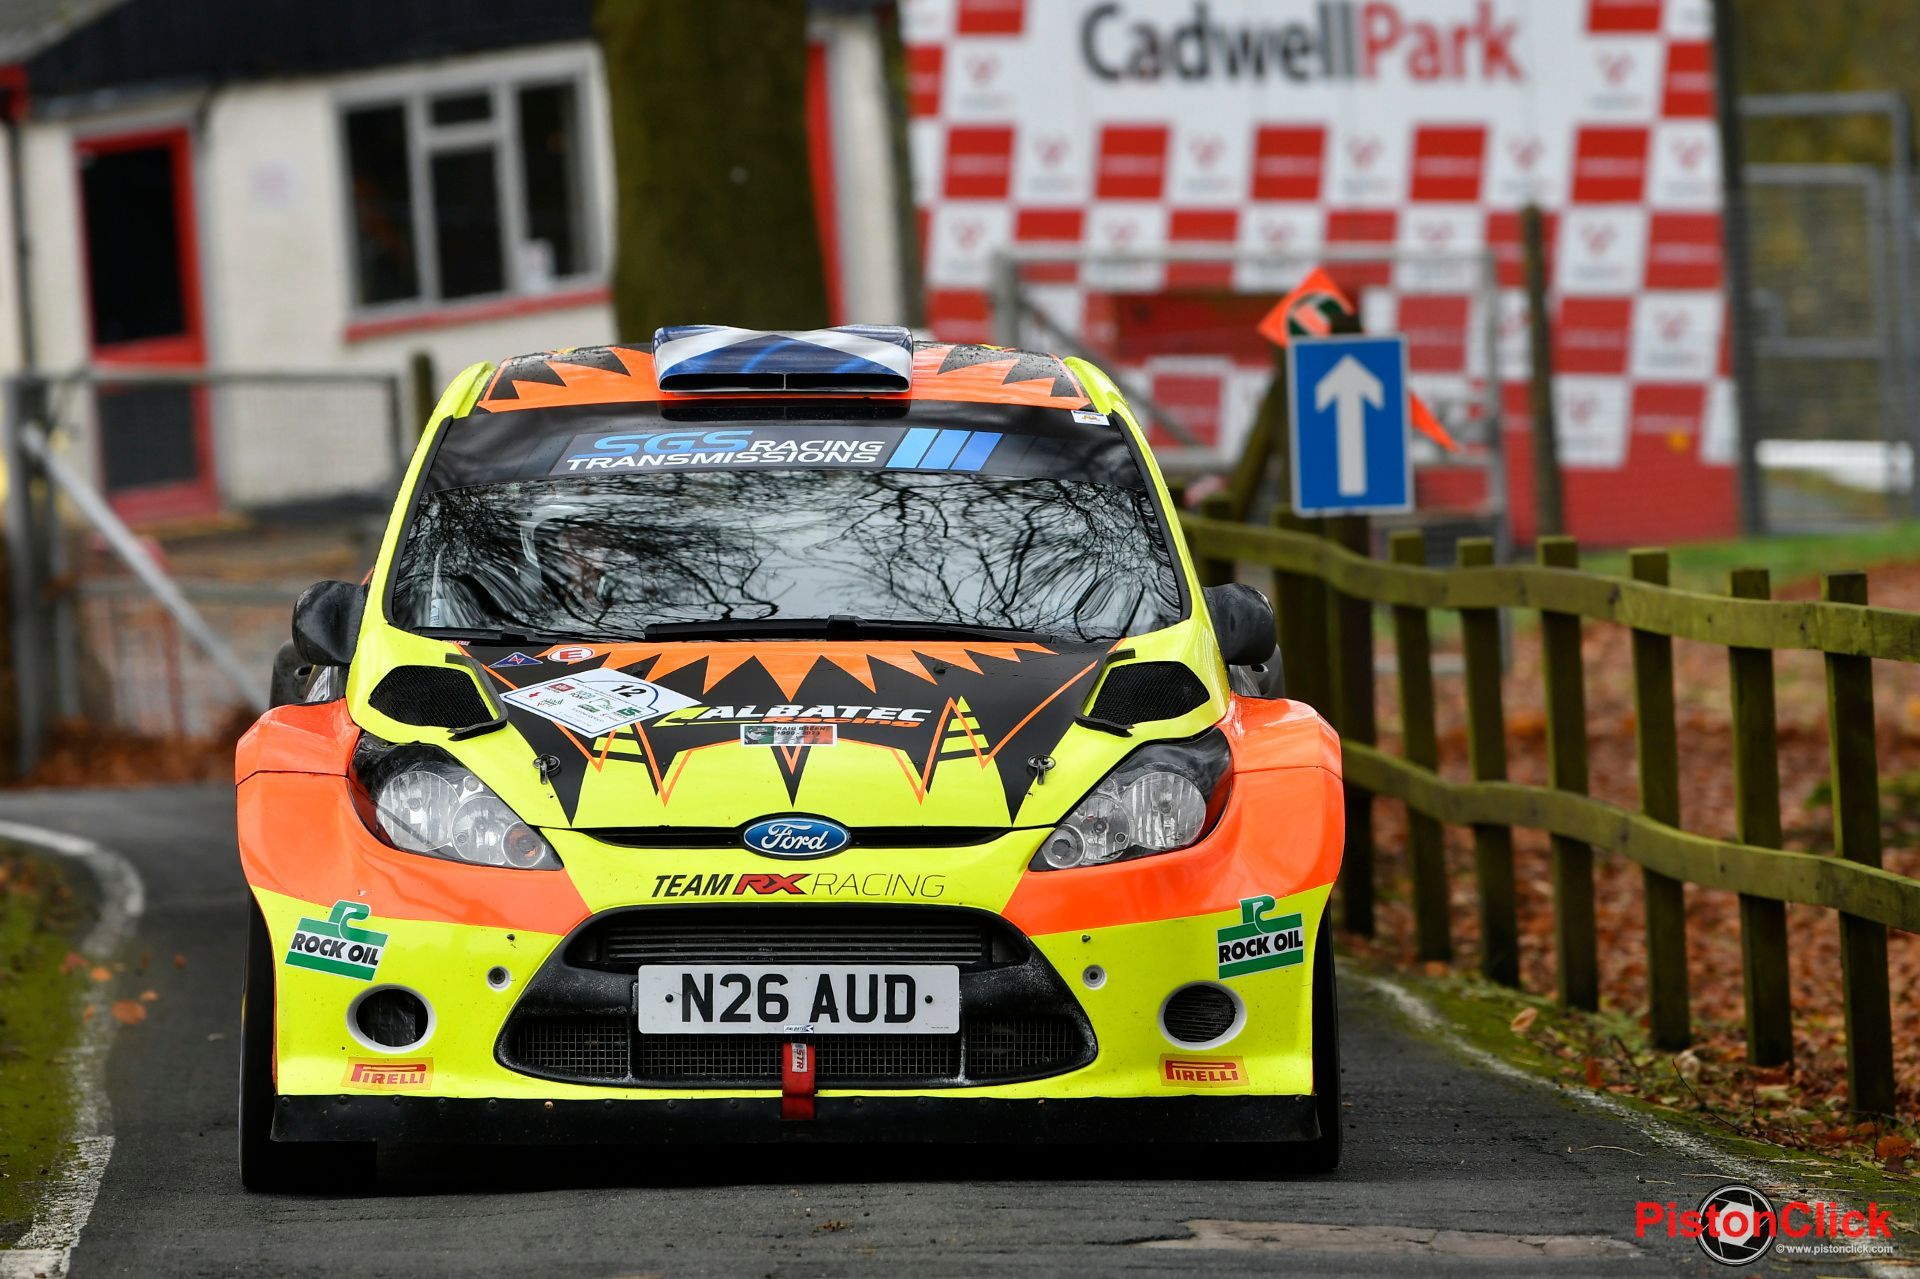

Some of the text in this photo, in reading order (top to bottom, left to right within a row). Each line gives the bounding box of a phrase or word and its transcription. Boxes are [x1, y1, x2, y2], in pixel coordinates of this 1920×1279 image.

[573, 430, 885, 459] SGS RACING
[567, 450, 878, 471] TRANSMISSIONS
[611, 684, 647, 697] 12
[697, 705, 932, 722] ALBATEC
[760, 716, 921, 728] Racing
[761, 823, 830, 850] Ford
[651, 873, 946, 898] TEAM RX RACING
[291, 933, 379, 966] ROCK OIL
[1218, 930, 1303, 964] ROCK OIL
[681, 973, 916, 1024] N26 AUD
[350, 1063, 427, 1085] PIRELLI
[1165, 1060, 1239, 1082] PIRELLI
